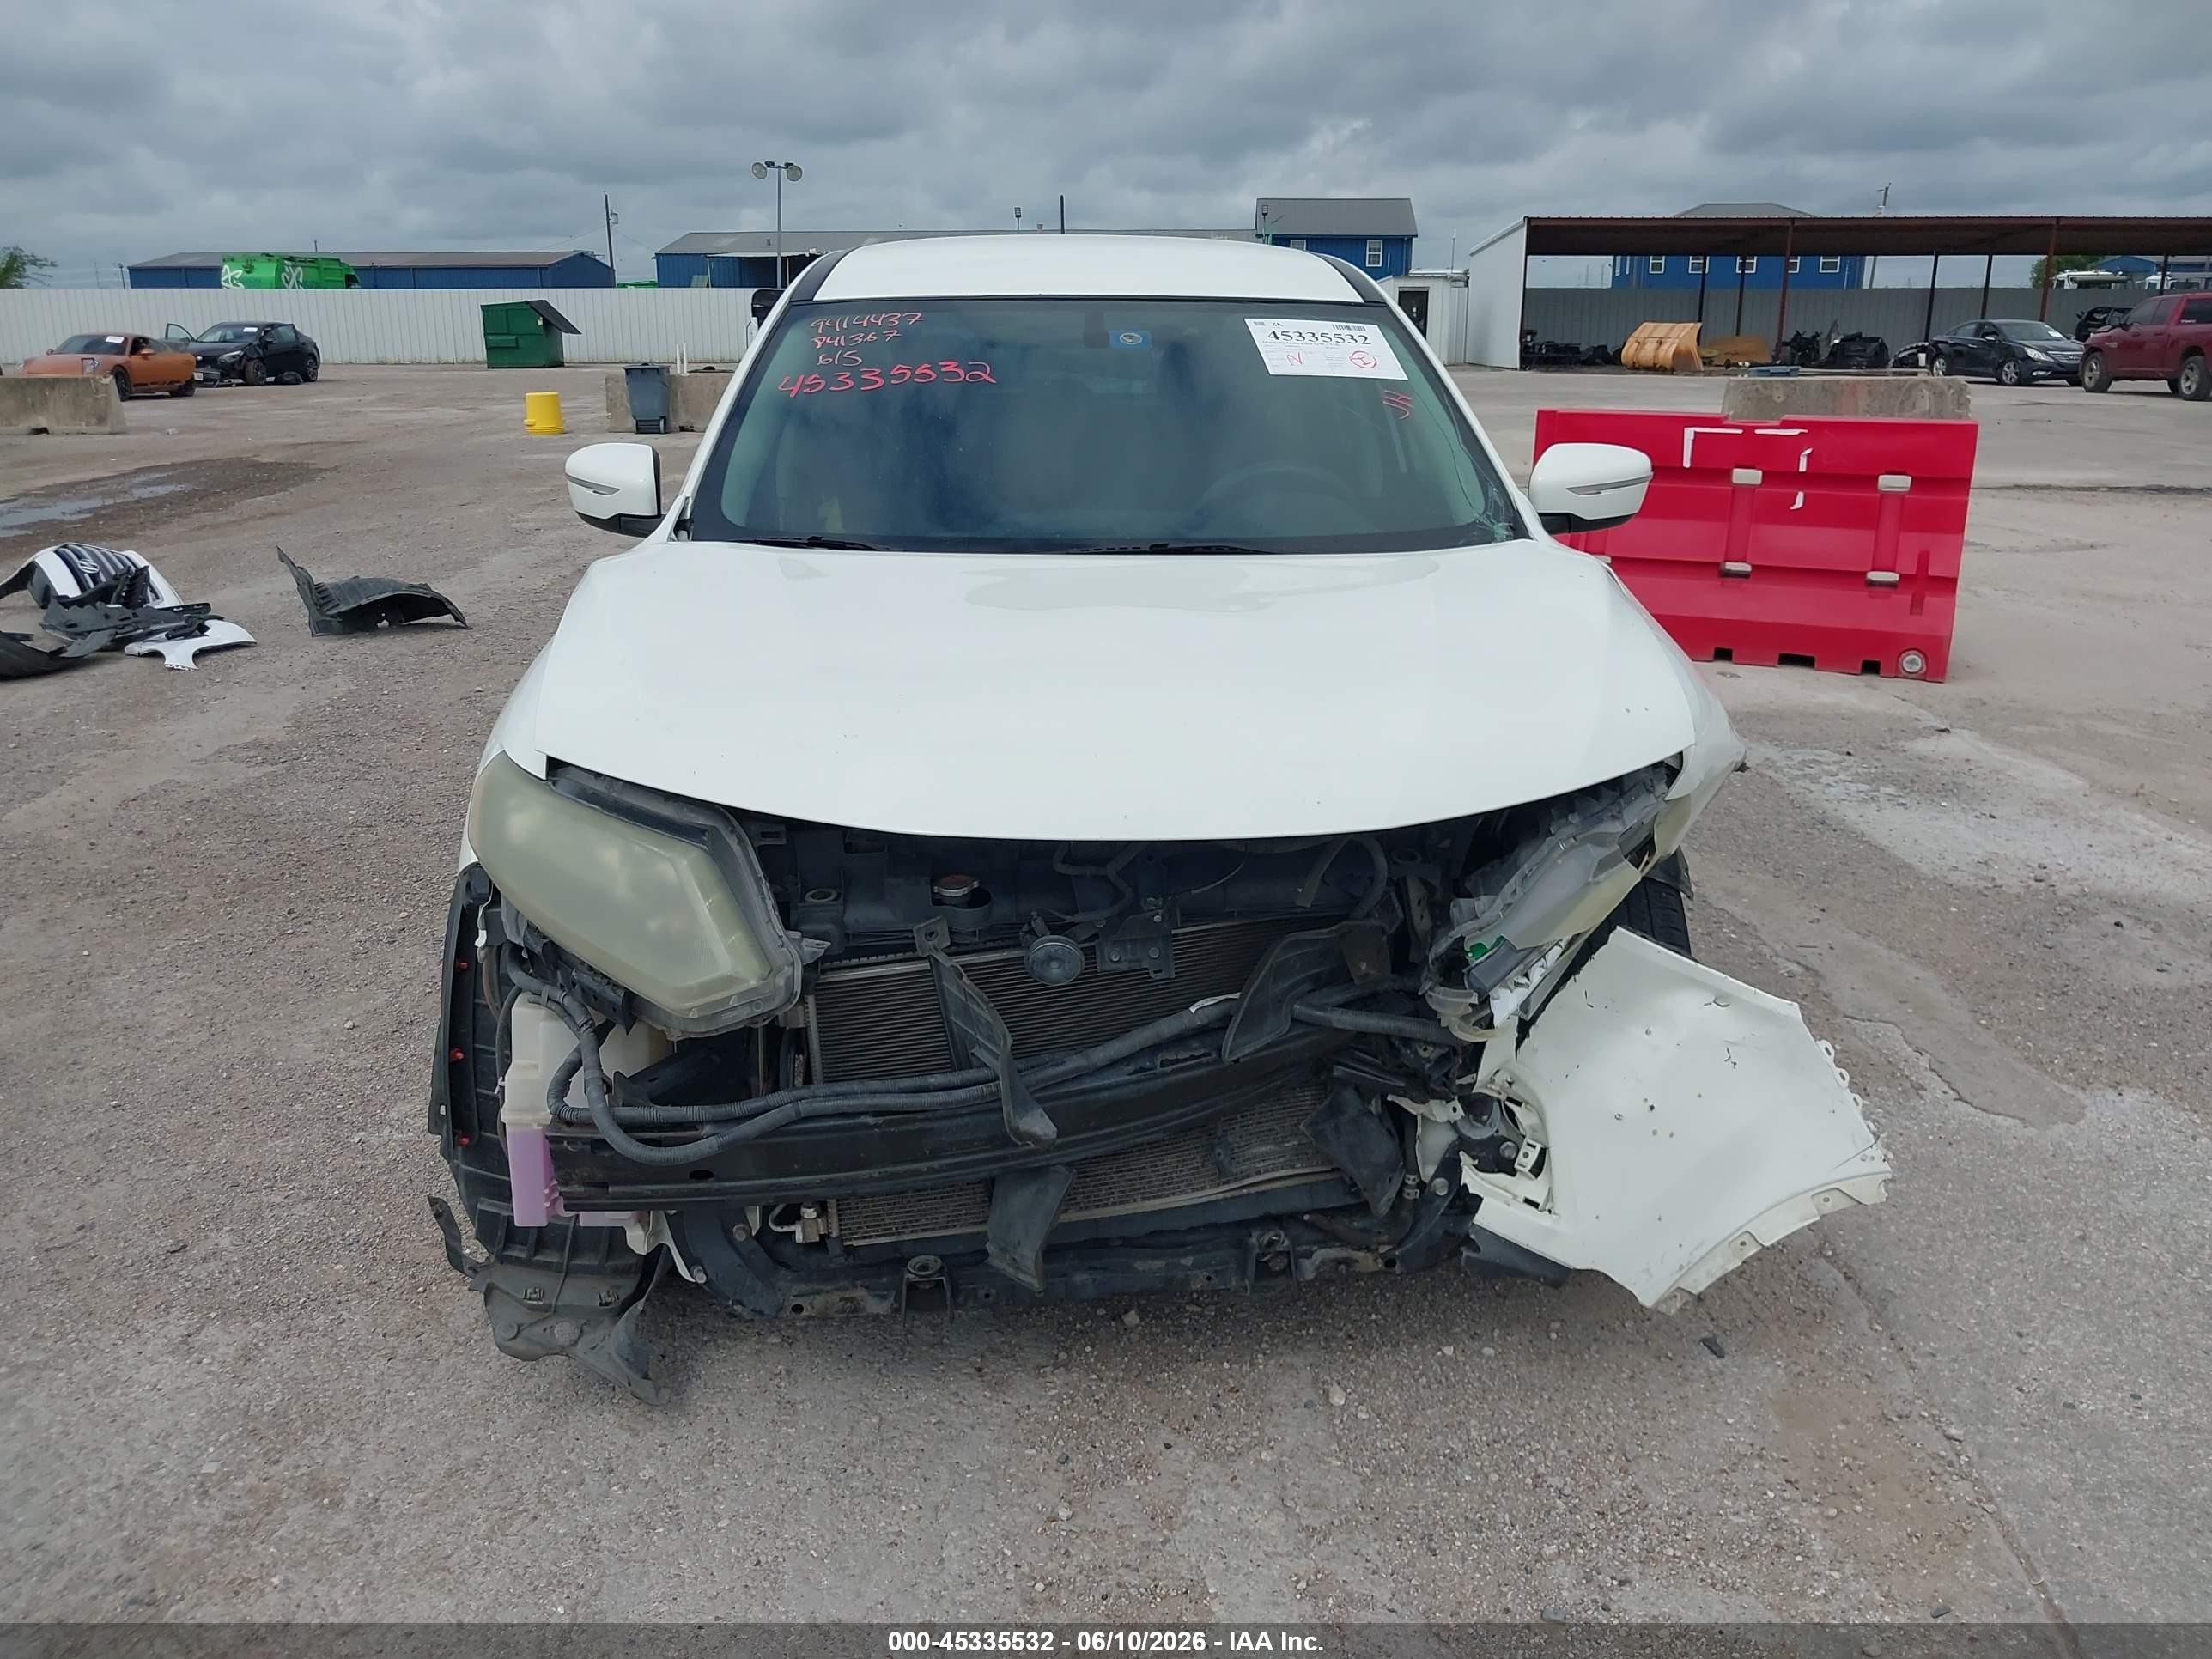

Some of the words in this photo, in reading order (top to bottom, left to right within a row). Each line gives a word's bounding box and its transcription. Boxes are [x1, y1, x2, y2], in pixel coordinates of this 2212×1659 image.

[811, 312, 925, 334] 9414437
[1267, 330, 1371, 345] 45335532
[777, 361, 997, 398] 45335532
